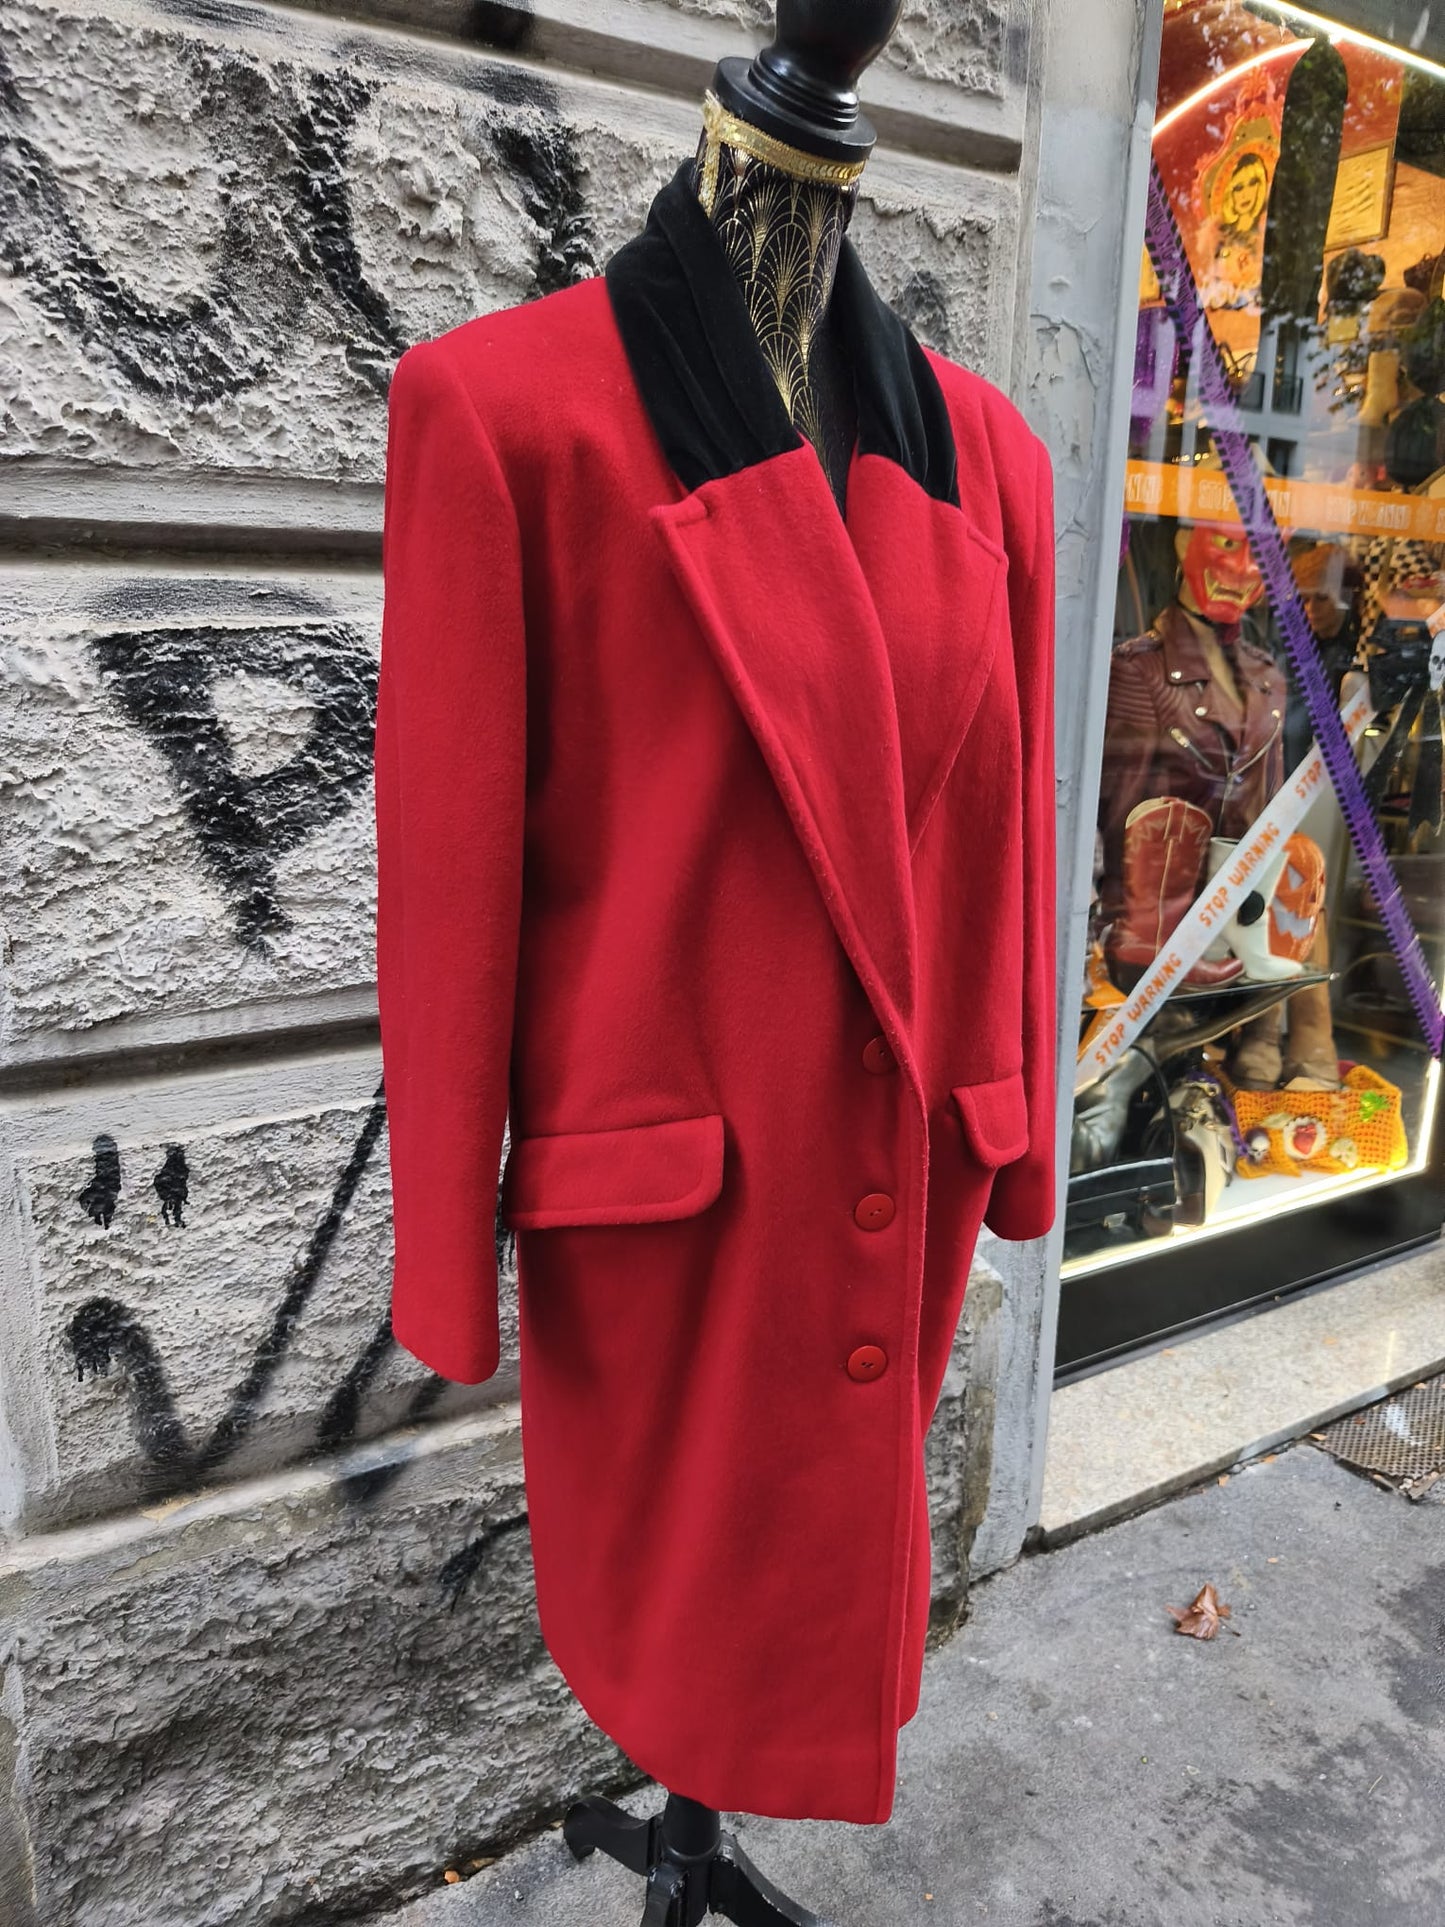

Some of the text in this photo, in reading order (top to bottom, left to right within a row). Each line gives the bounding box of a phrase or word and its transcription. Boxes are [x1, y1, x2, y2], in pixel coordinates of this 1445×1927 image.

[1295, 760, 1322, 798] STOP
[1199, 822, 1280, 928] STOP WARNING
[1095, 1023, 1125, 1066] STOP
[1127, 953, 1182, 1022] WARNING
